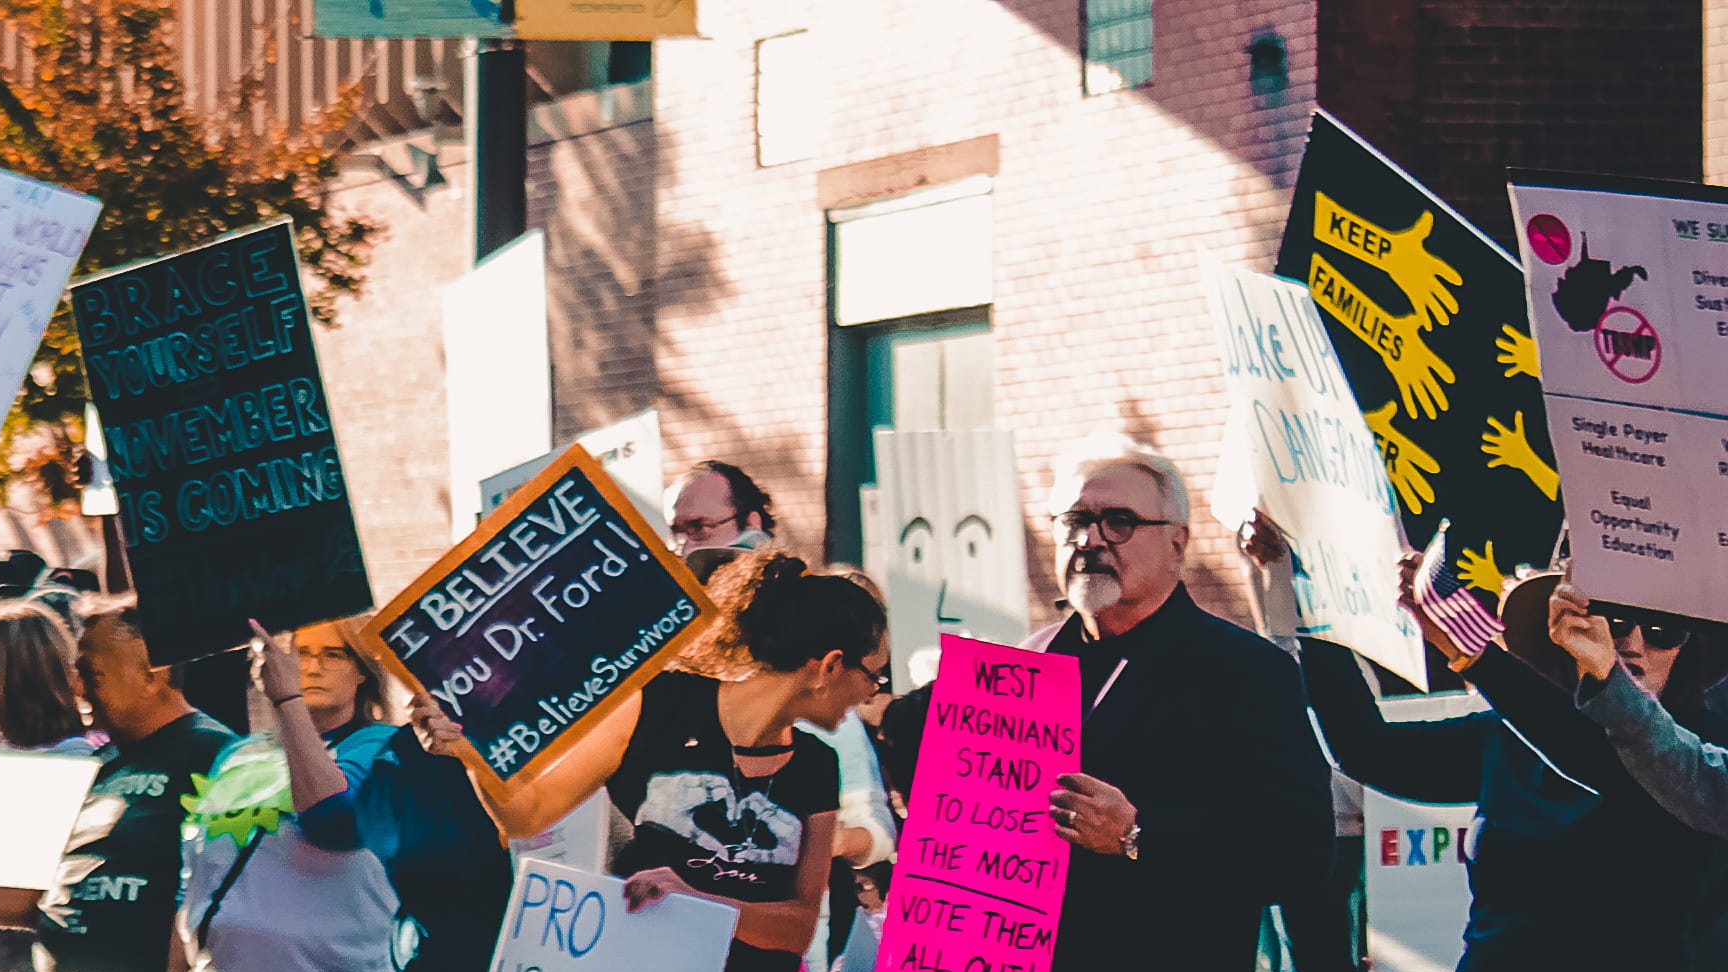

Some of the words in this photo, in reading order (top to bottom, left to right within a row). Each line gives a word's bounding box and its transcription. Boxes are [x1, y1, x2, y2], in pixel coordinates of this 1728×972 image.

[1329, 212, 1392, 260] KEEP
[73, 233, 289, 348] BRACE
[1313, 266, 1404, 362] FAMILIES
[89, 292, 301, 399] YOURSELF
[103, 377, 329, 484] NOVEMBER
[1572, 416, 1618, 439] Single
[1581, 440, 1666, 467] Healthcare
[177, 446, 344, 532] COMING
[1610, 490, 1652, 511] Equal
[119, 491, 169, 548] IS
[1591, 510, 1680, 542] Opportunity
[389, 620, 430, 661] I
[419, 479, 597, 632] BELIEVE
[1602, 534, 1675, 561] Education
[432, 656, 492, 717] you
[483, 617, 545, 662] Dr.
[488, 598, 696, 773] #BelieveSurvivors
[974, 658, 1040, 700] WEST
[936, 701, 1075, 755] VIRGINIANS
[957, 748, 1041, 791] STAND
[936, 793, 963, 822] TO
[971, 802, 1046, 833] LOSE
[918, 838, 967, 870] THE
[976, 850, 1059, 889] MOST!
[512, 873, 606, 958] PRO
[900, 893, 971, 932] VOTE
[983, 910, 1052, 955] THEM
[900, 943, 951, 972] ALL
